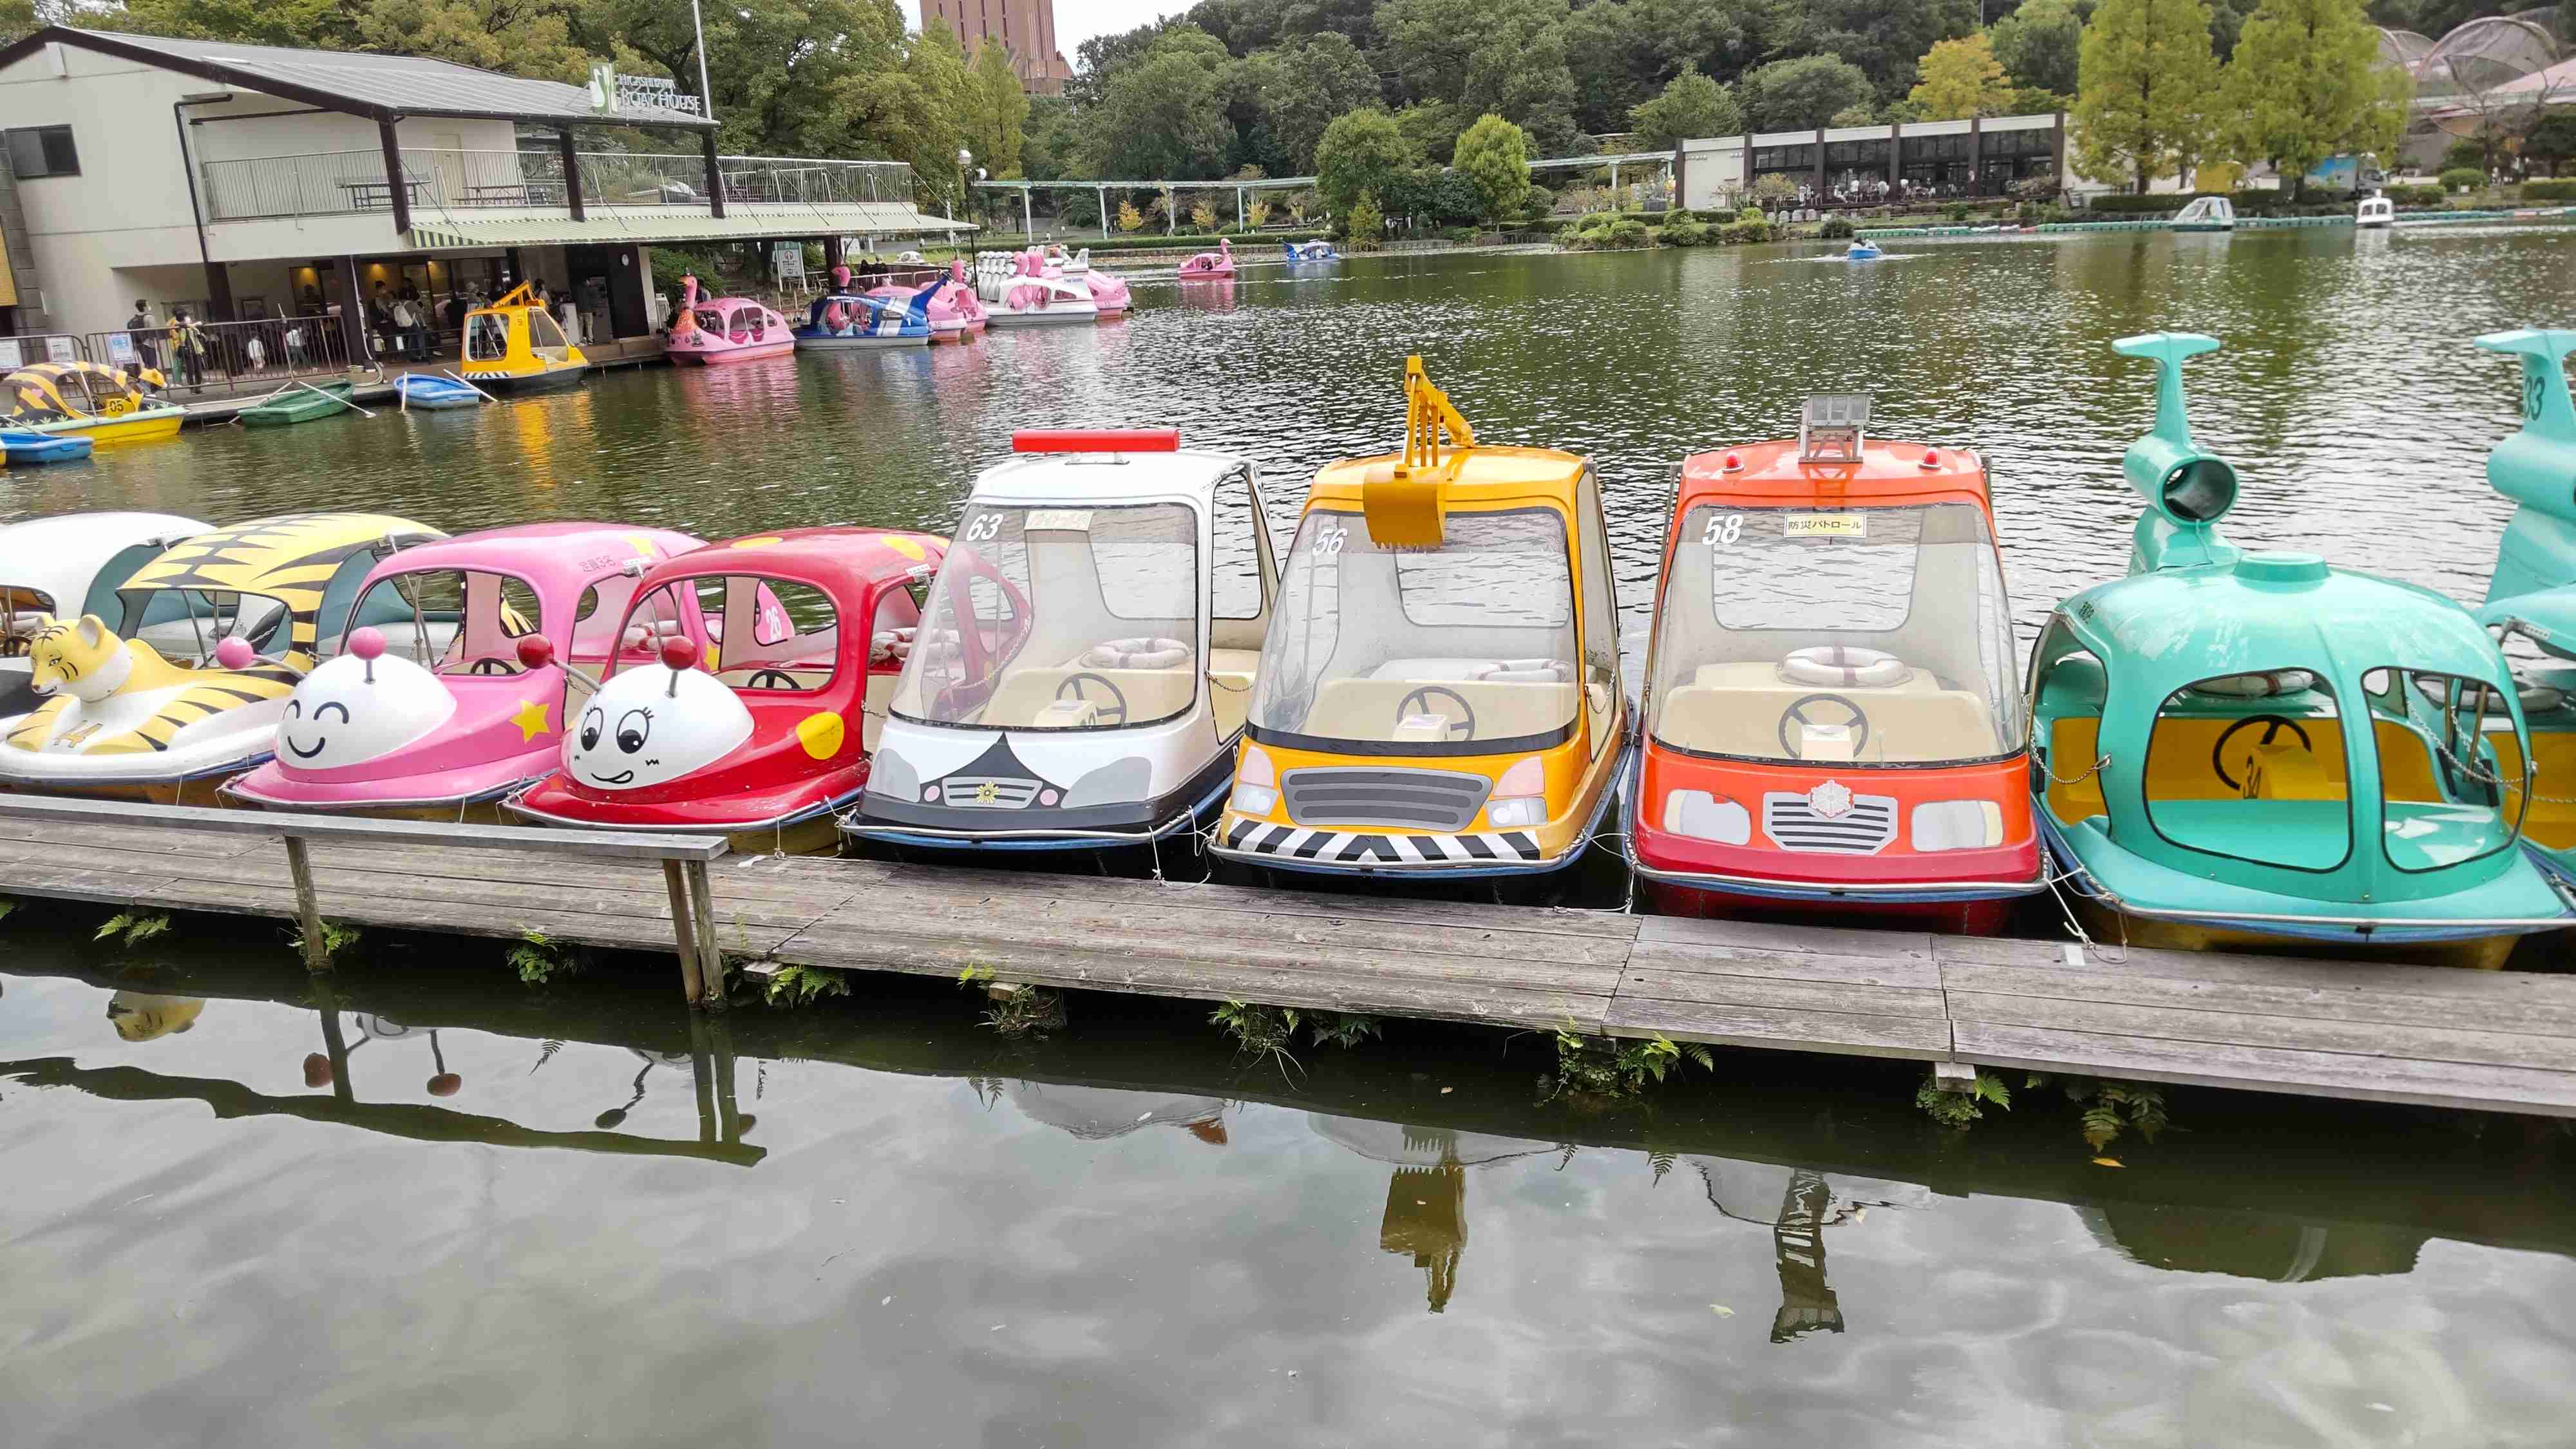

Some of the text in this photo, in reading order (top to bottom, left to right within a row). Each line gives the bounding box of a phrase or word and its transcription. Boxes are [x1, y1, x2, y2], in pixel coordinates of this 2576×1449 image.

[620, 88, 701, 111] BOAT HOUSE
[907, 317, 911, 327] 1
[109, 401, 124, 412] 05
[966, 514, 1004, 541] 63
[1702, 515, 1744, 545] 58
[1788, 520, 1861, 530] 防災パトロール
[1312, 528, 1348, 555] 56
